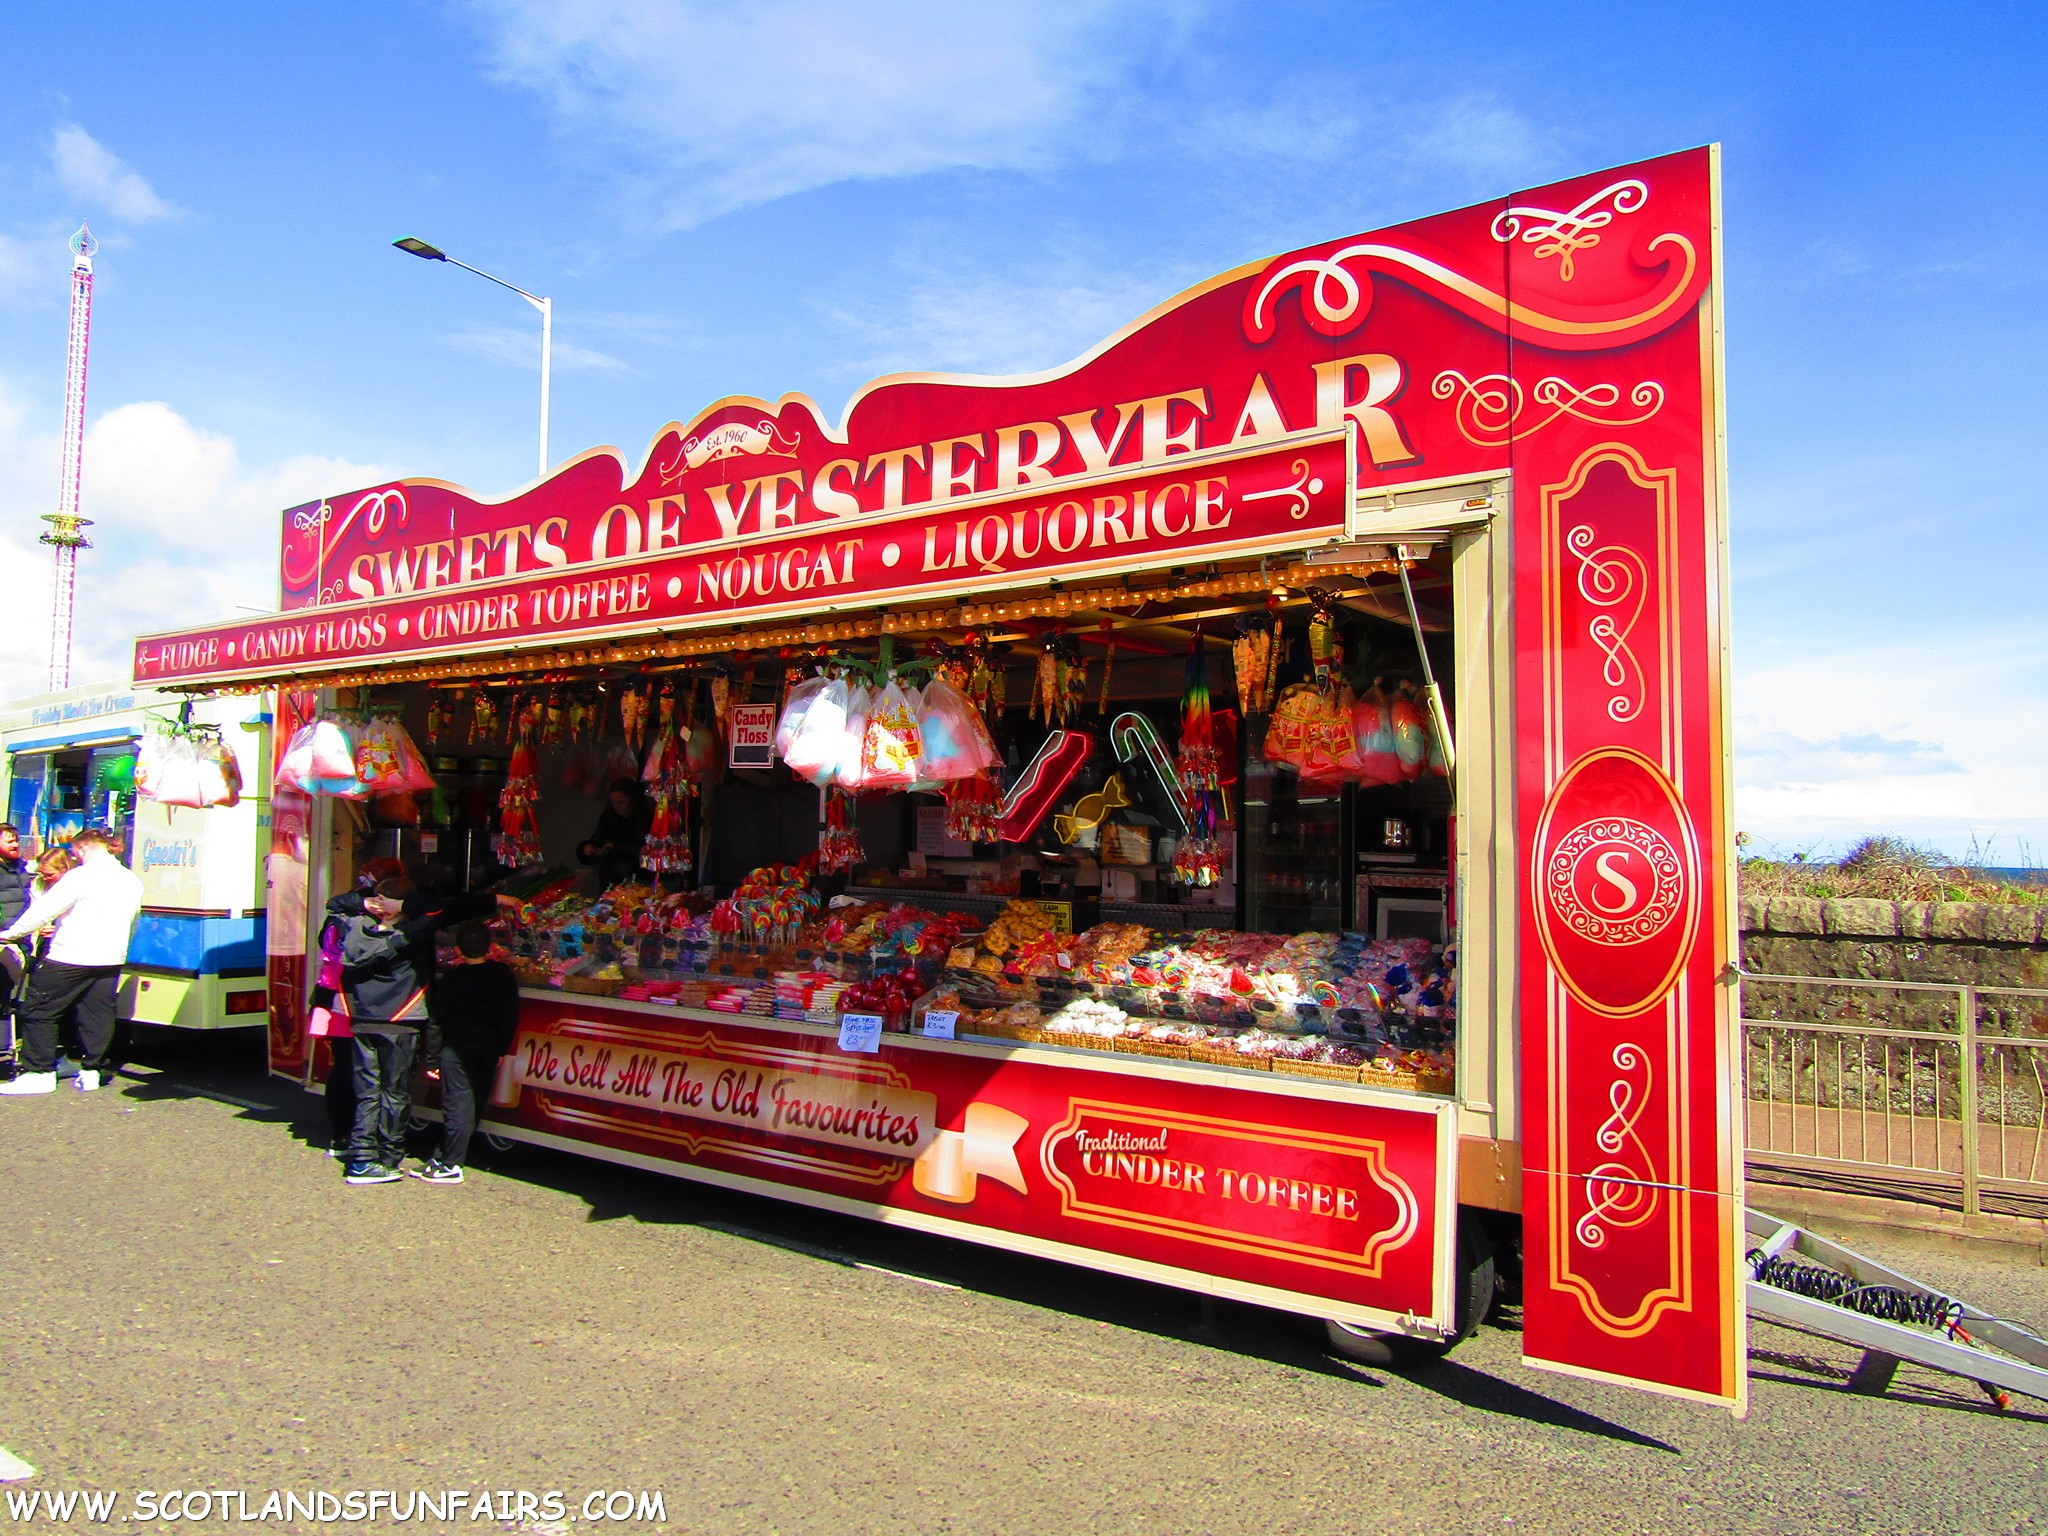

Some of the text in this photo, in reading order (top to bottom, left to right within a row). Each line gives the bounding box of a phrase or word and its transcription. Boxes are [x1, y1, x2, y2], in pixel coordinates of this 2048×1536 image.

[706, 430, 748, 451] Est. 1960
[348, 353, 1416, 600] SWEETS OF YESTERYEAR
[159, 476, 1233, 672] FUDGE CANDY FLOSS CINDER TOFFEE NOUGAT LIQUORICE
[735, 709, 773, 743] Candy Floss
[1591, 851, 1638, 914] S
[525, 1038, 920, 1148] We Sell All The Old Favourites
[1075, 1127, 1168, 1153] Traditional
[1082, 1150, 1360, 1222] CINDER TOFFEE
